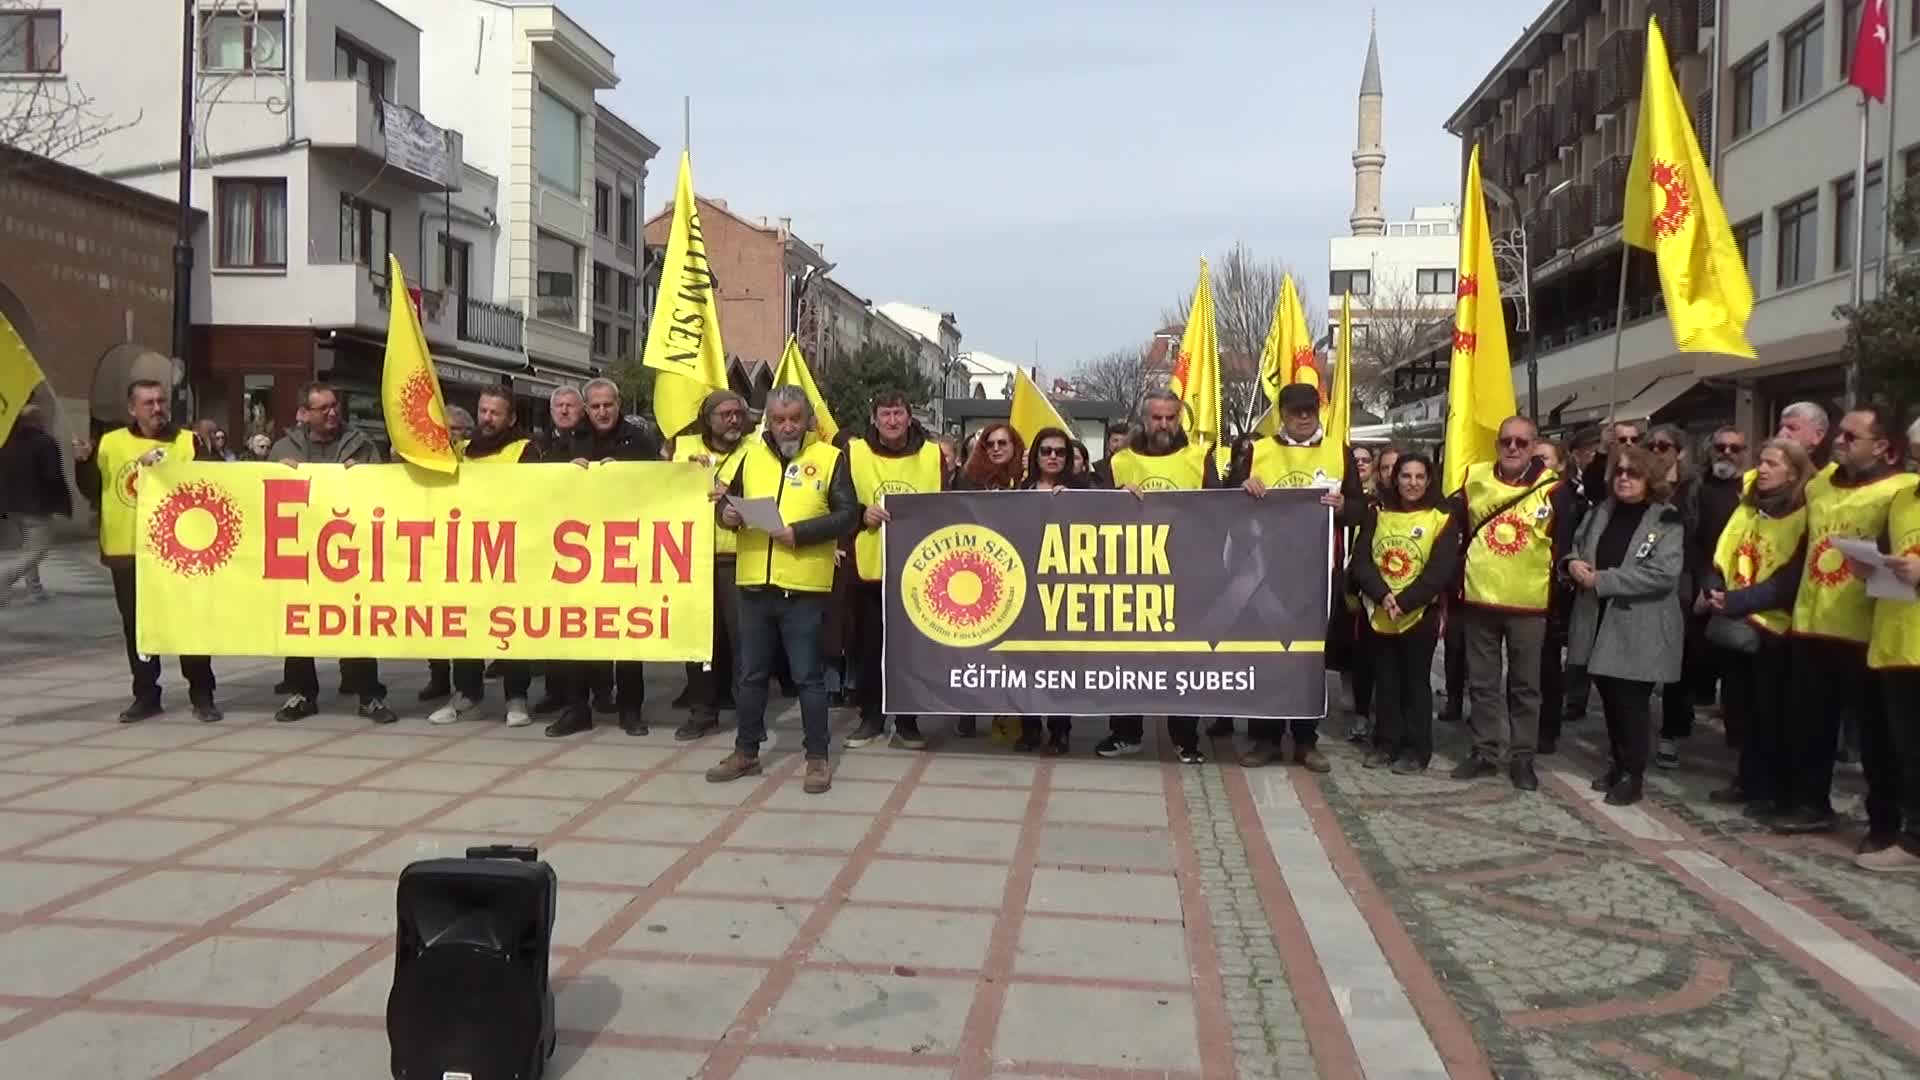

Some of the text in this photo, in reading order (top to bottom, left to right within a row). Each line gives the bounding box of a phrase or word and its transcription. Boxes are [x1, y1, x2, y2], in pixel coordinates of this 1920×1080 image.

[665, 308, 705, 370] SEN
[262, 478, 696, 584] EĞİTİM SEN
[912, 531, 1018, 573] EĞİTİM SEN
[1036, 523, 1171, 576] ARTIK
[285, 593, 670, 651] EDİRNE ŞUBESİ
[1037, 583, 1176, 632] YETER!
[949, 664, 1256, 697] EĞİTİM SEN EDİRNE ŞUBESİ
